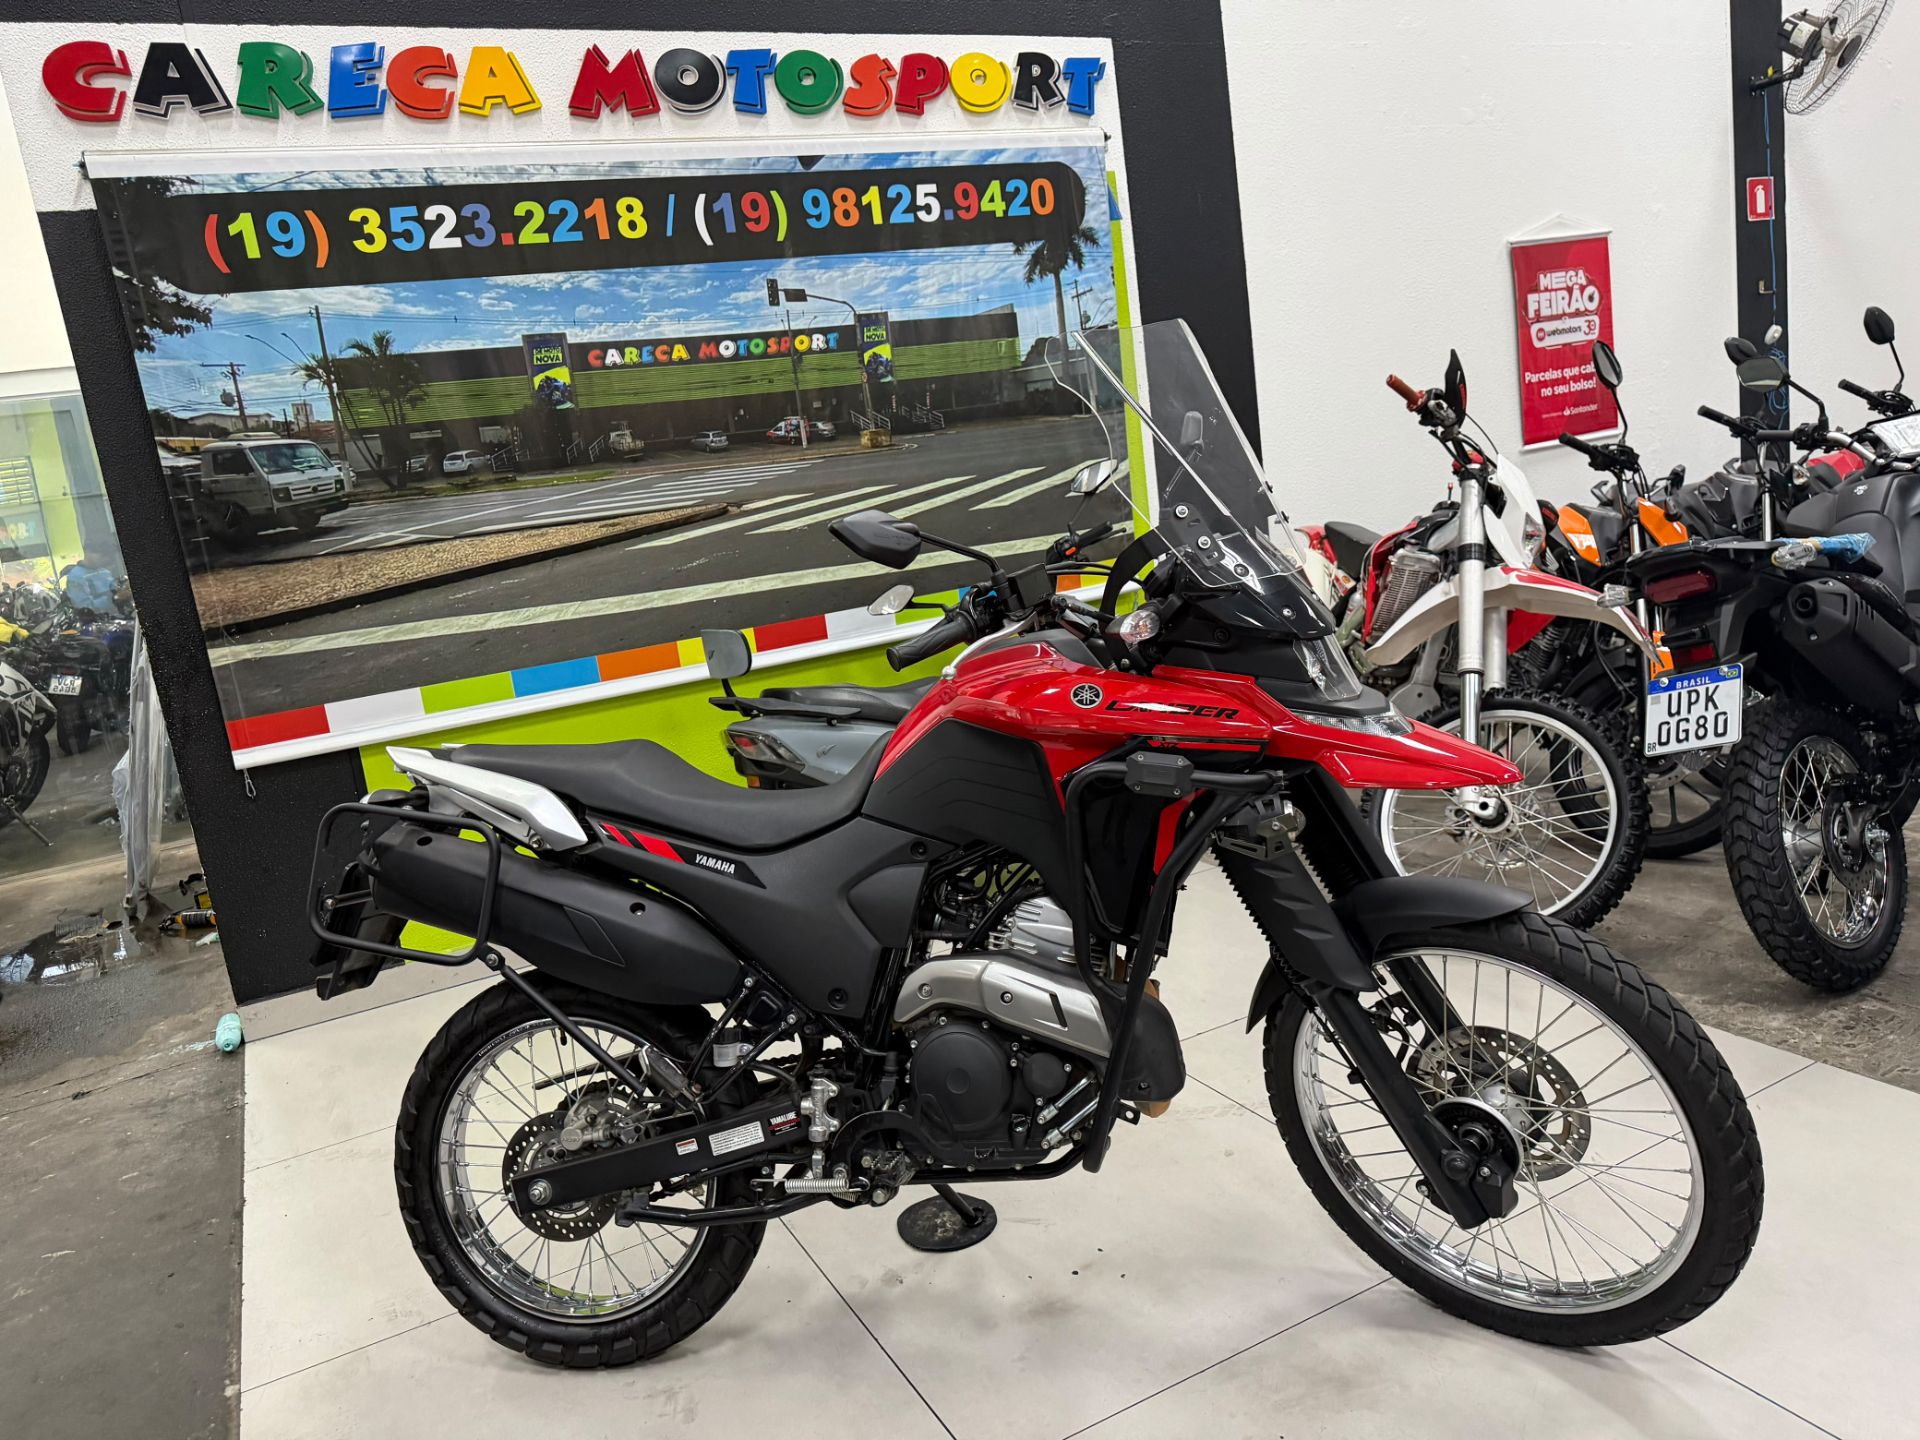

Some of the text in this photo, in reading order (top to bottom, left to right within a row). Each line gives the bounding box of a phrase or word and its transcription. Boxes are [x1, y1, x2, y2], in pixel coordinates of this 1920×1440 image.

[42, 40, 1105, 121] CARECA MOTOSPORT
[204, 210, 330, 274] (19)
[348, 196, 648, 254] 3523.2218
[694, 190, 788, 247] (19)
[805, 178, 1055, 230] 98125.9420
[1539, 270, 1587, 290] MEGA
[1527, 285, 1600, 319] FEIRÃO
[1546, 325, 1582, 337] webmotors
[535, 354, 561, 364] NOVA
[587, 331, 840, 368] CARECA MOTOSPORT
[1524, 361, 1596, 384] Parcelas que cab
[1541, 376, 1597, 397] no seu bolso!
[1570, 403, 1599, 415] Santander
[1676, 676, 1711, 689] BRASIL
[1105, 700, 1240, 720] LDER
[1667, 685, 1720, 718] UPK
[1647, 742, 1657, 752] BR
[694, 853, 736, 875] YAMAHA
